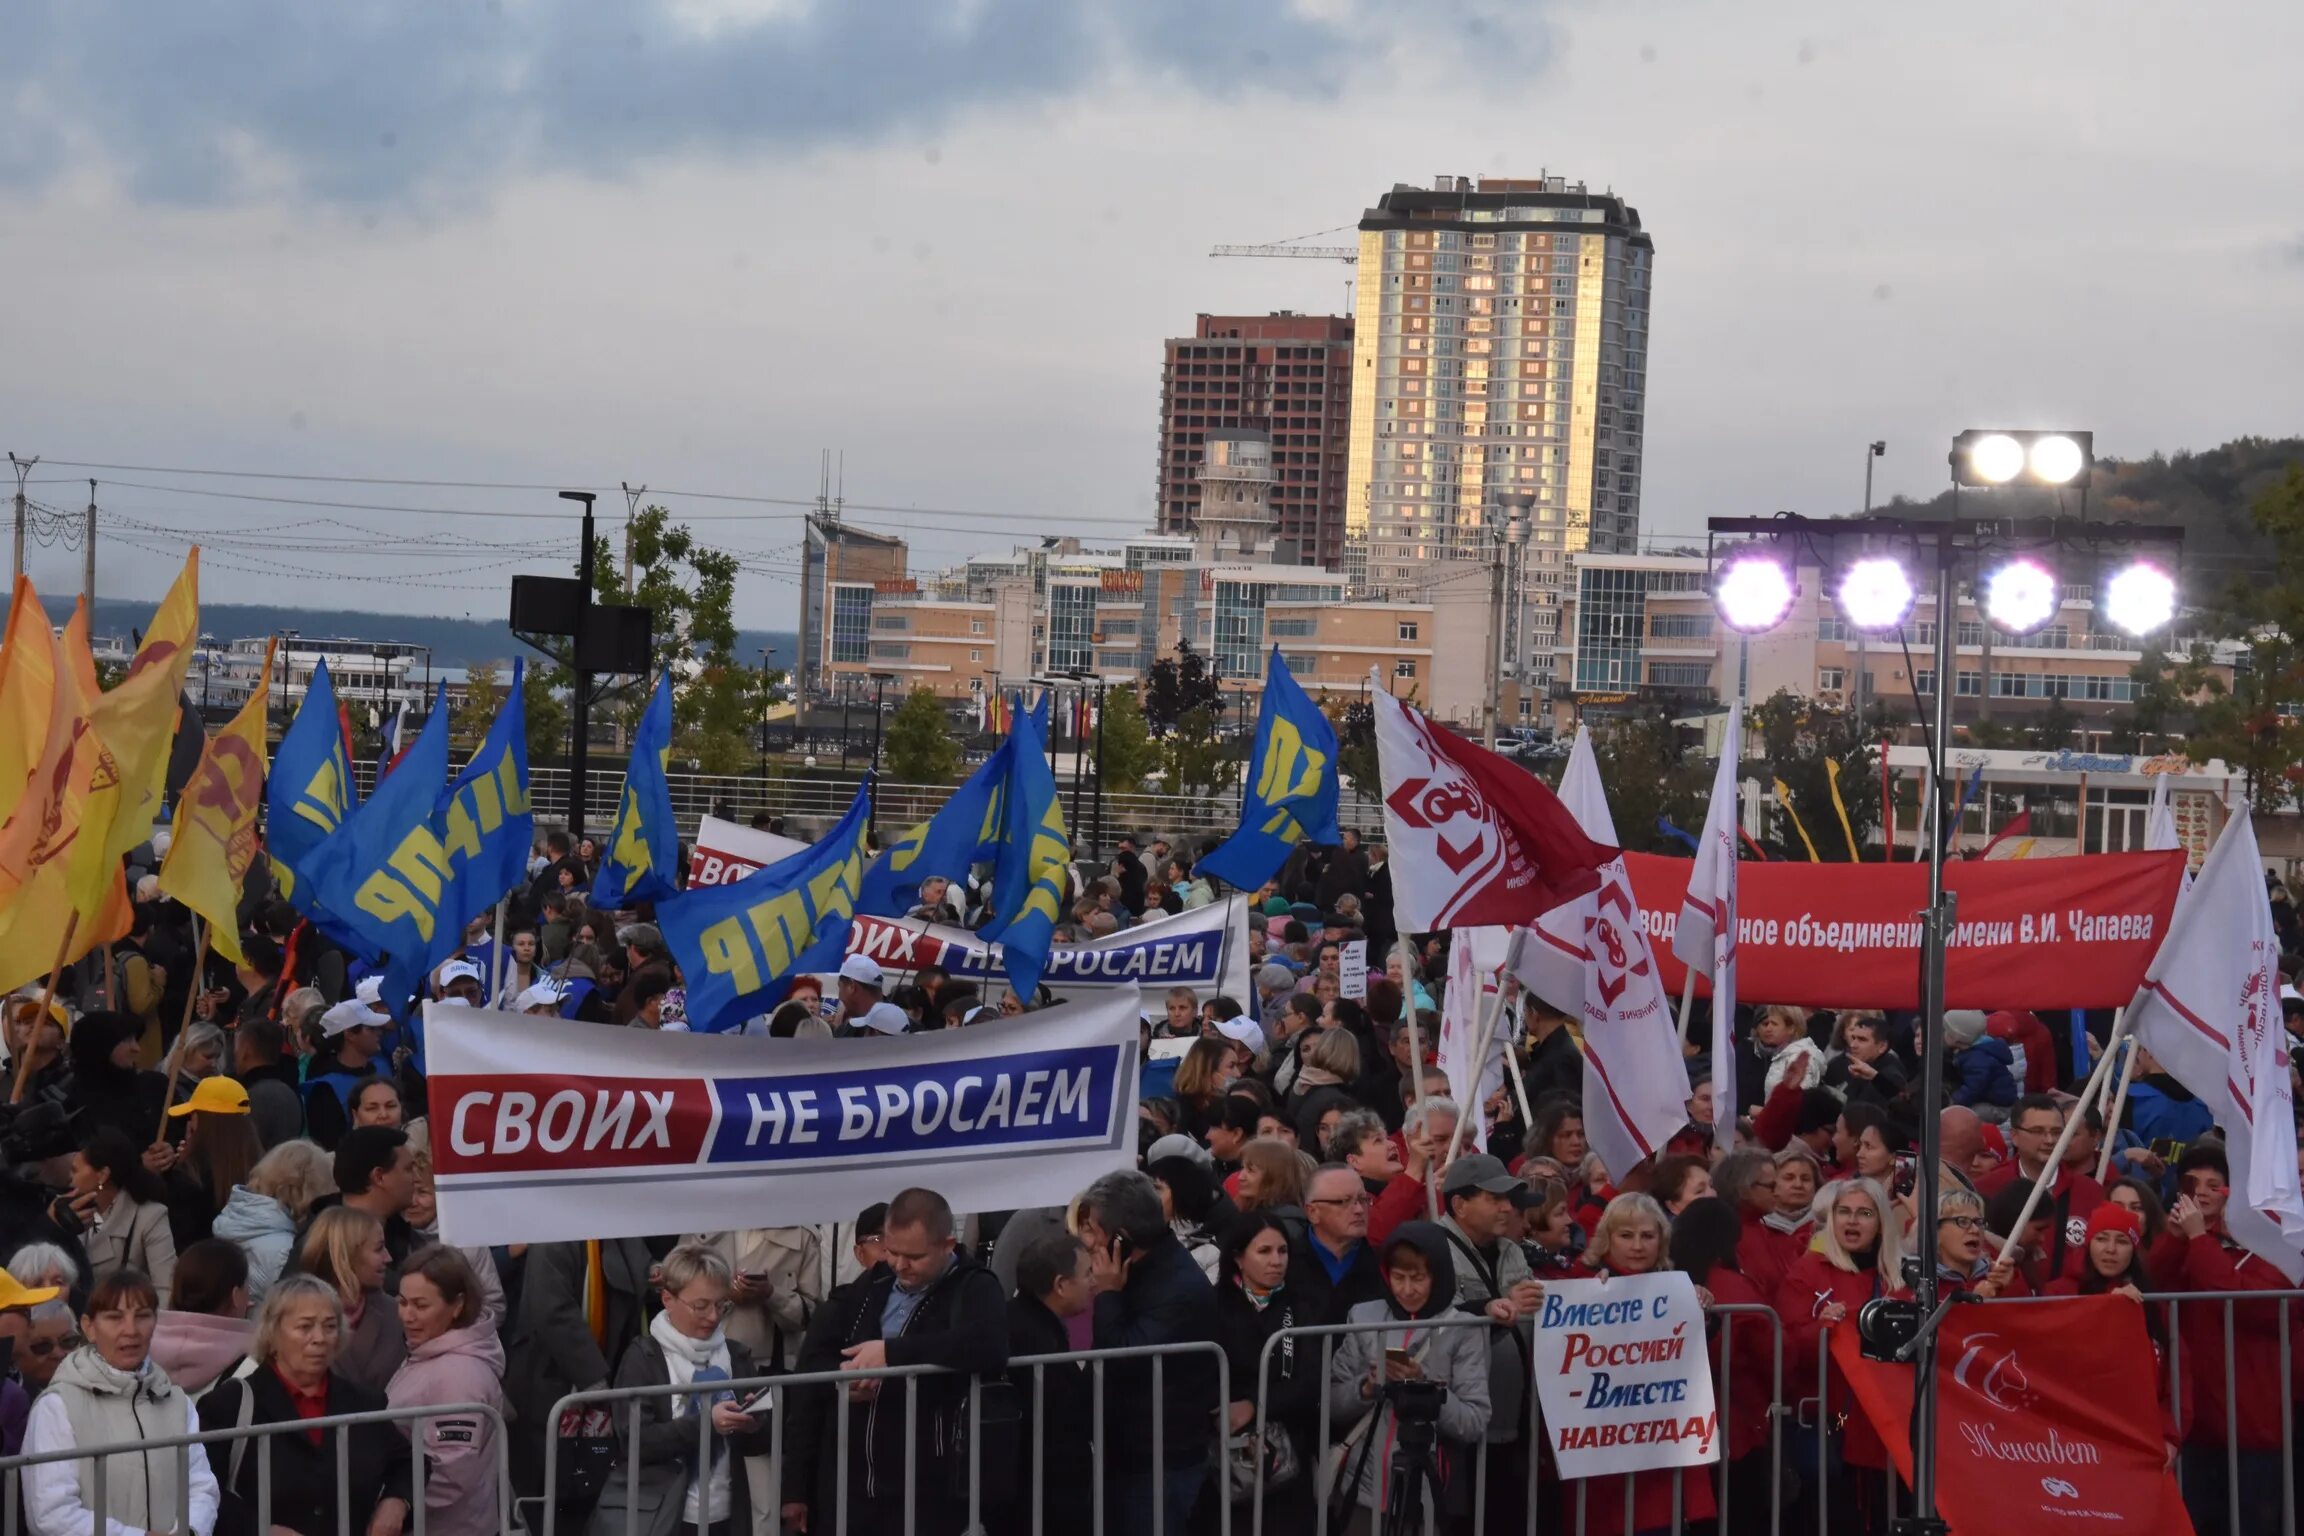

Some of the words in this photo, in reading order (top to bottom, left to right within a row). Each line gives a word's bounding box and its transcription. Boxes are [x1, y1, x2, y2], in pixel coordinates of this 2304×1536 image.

[1785, 912, 1924, 952] объединени
[2019, 914, 2061, 944] В.И.
[2068, 909, 2154, 943] Чапаева
[1044, 941, 1205, 976] РОСАЕМ
[450, 1088, 676, 1156] СВОИХ
[745, 1089, 823, 1147] НЕ
[837, 1066, 1093, 1141] БРОСАЕМ
[1541, 1294, 1643, 1329] Вместе
[1652, 1295, 1668, 1319] с
[1558, 1411, 1717, 1455] НАВСЕГДА!
[1959, 1421, 2100, 1465] Женсовет
